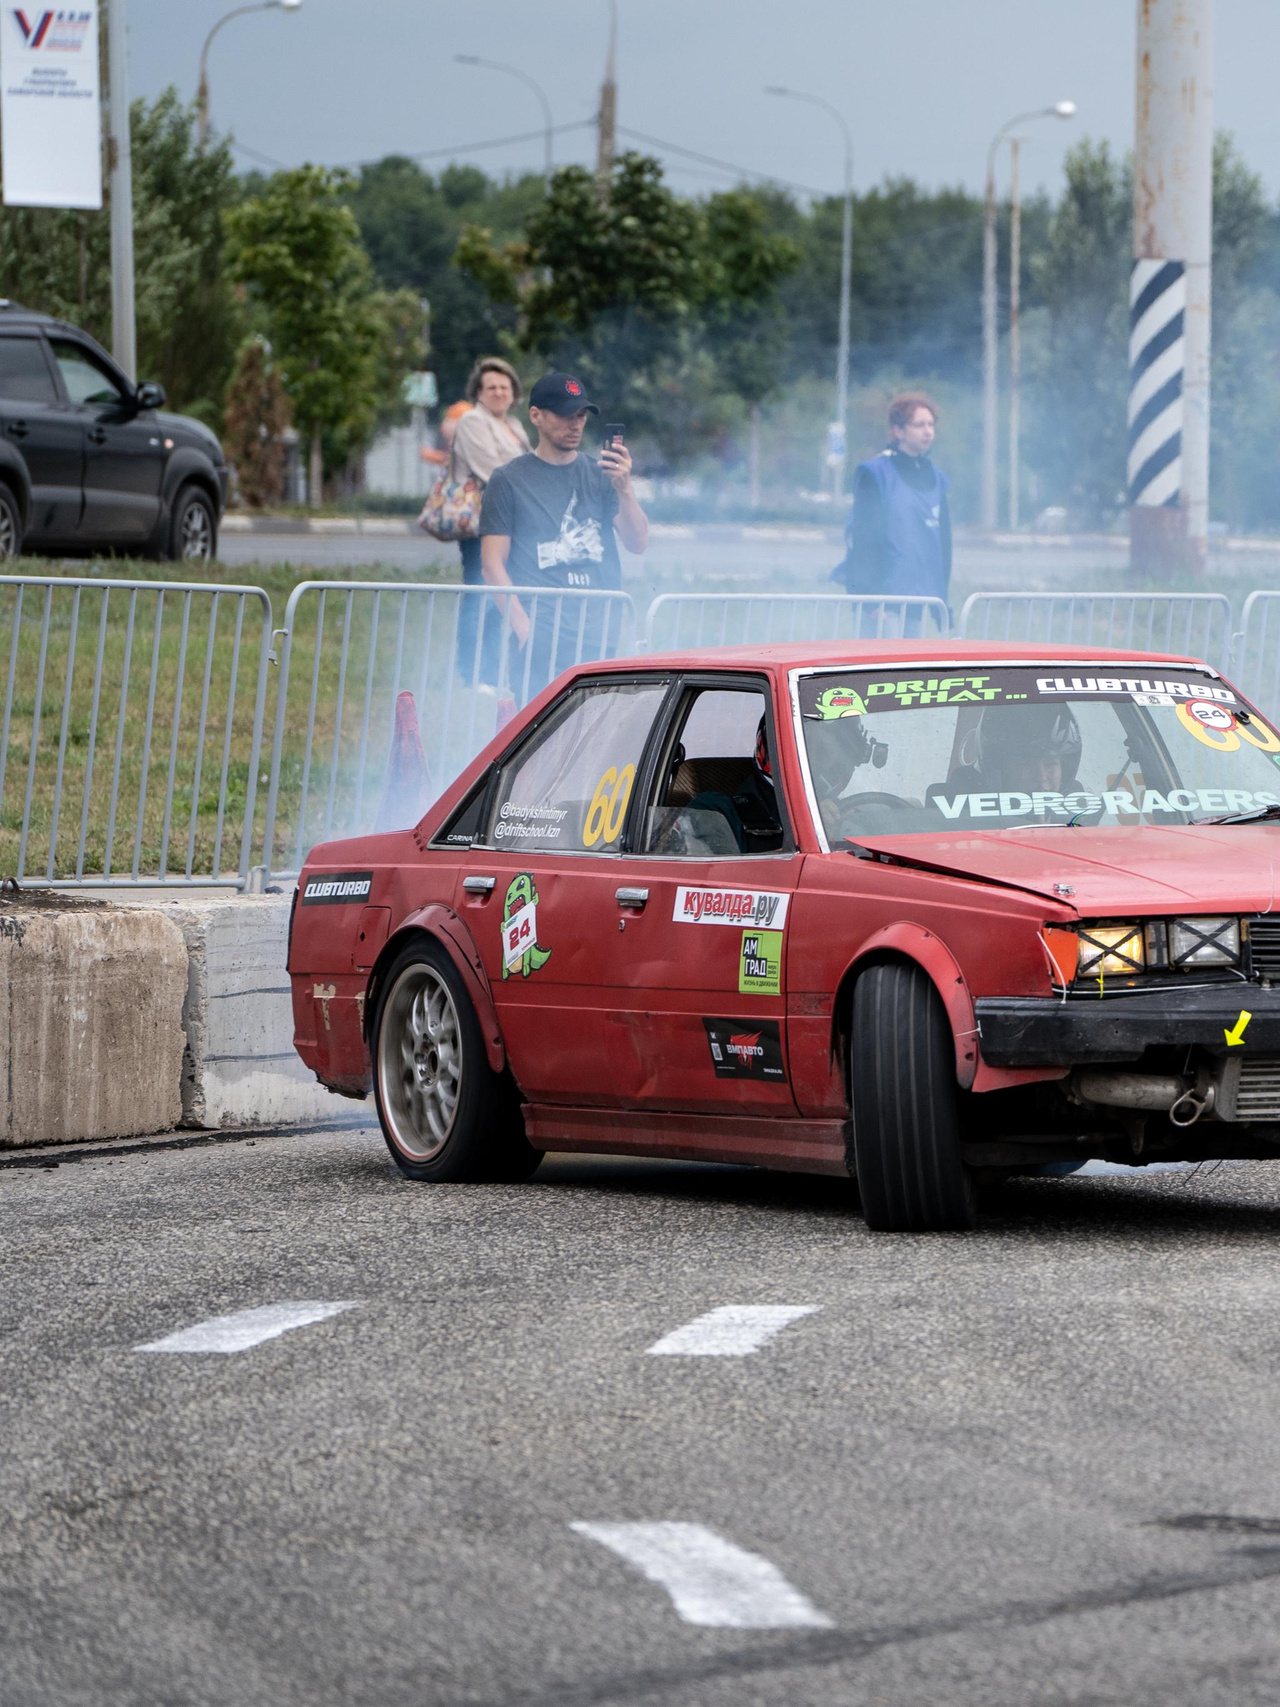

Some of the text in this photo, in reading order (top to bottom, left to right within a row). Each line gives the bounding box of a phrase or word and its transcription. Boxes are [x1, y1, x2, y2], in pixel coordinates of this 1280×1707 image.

[867, 677, 990, 696] DRIFT
[1036, 678, 1237, 703] CLUBTURBO
[1195, 708, 1226, 720] 24
[582, 763, 635, 848] 60
[447, 834, 473, 842] CARINA
[304, 880, 371, 898] CLUBTURBO
[683, 891, 780, 926] кувалда.ру
[509, 917, 531, 951] 24
[743, 939, 758, 955] АМ
[745, 959, 766, 976] ГРАД
[726, 1044, 764, 1057] ВМПАВТО
